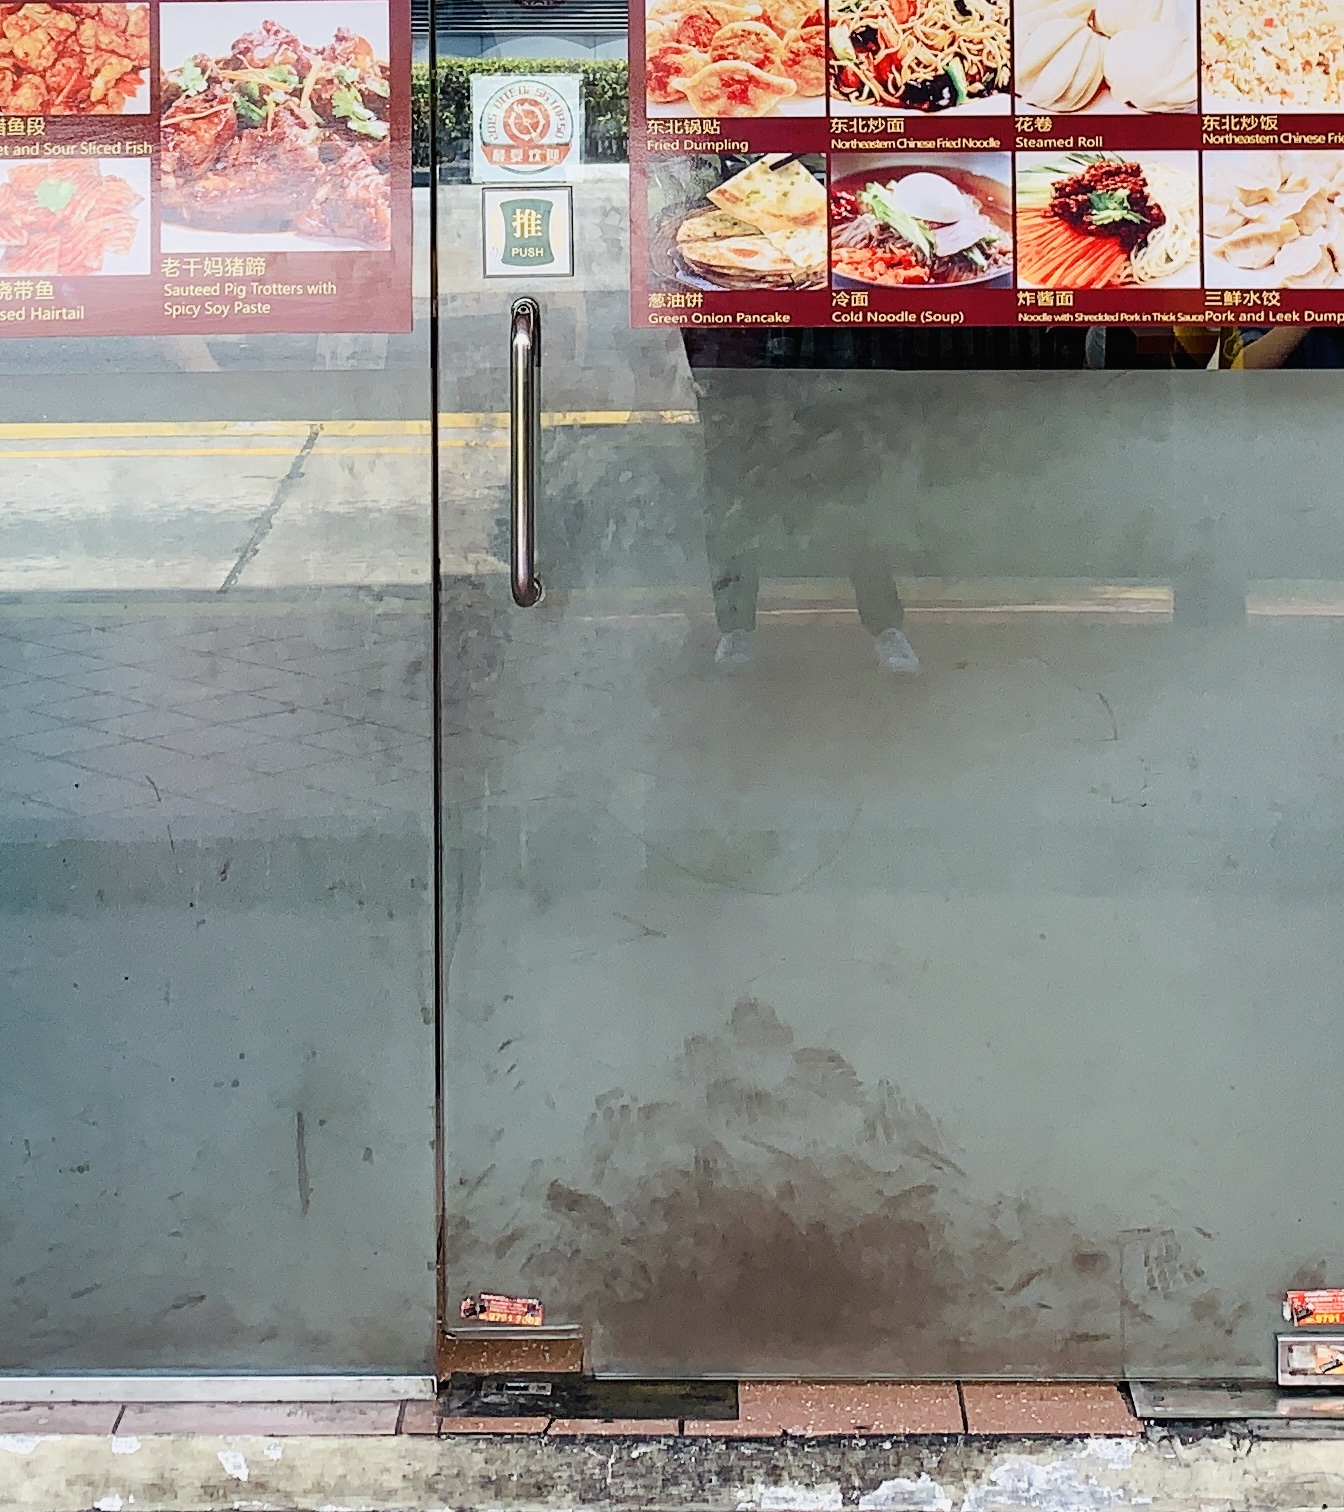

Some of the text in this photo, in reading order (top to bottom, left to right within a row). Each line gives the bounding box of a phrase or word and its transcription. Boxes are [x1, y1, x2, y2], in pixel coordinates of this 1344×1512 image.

[645, 117, 720, 136] 东北锅贴
[830, 118, 904, 133] 东北炒面
[1015, 116, 1052, 132] 花卷
[1202, 115, 1278, 131] 东北炒饭
[647, 139, 748, 154] Fried Dumpling
[1016, 136, 1102, 148] Steamed Roll
[492, 148, 560, 163] 最受欢迎
[511, 207, 543, 239] 推
[511, 247, 544, 258] PUSH
[832, 291, 868, 307] 冷面
[1204, 290, 1280, 306] 三鲜水饺
[31, 305, 84, 320] Hairtail
[164, 301, 270, 318] Spicy Soy Paste
[1205, 310, 1235, 322] Pork
[1239, 311, 1264, 321] and
[1269, 310, 1300, 322] Leek
[648, 312, 790, 326] Green Onion Pancake
[832, 311, 964, 324] Cold Noodle (Soup)
